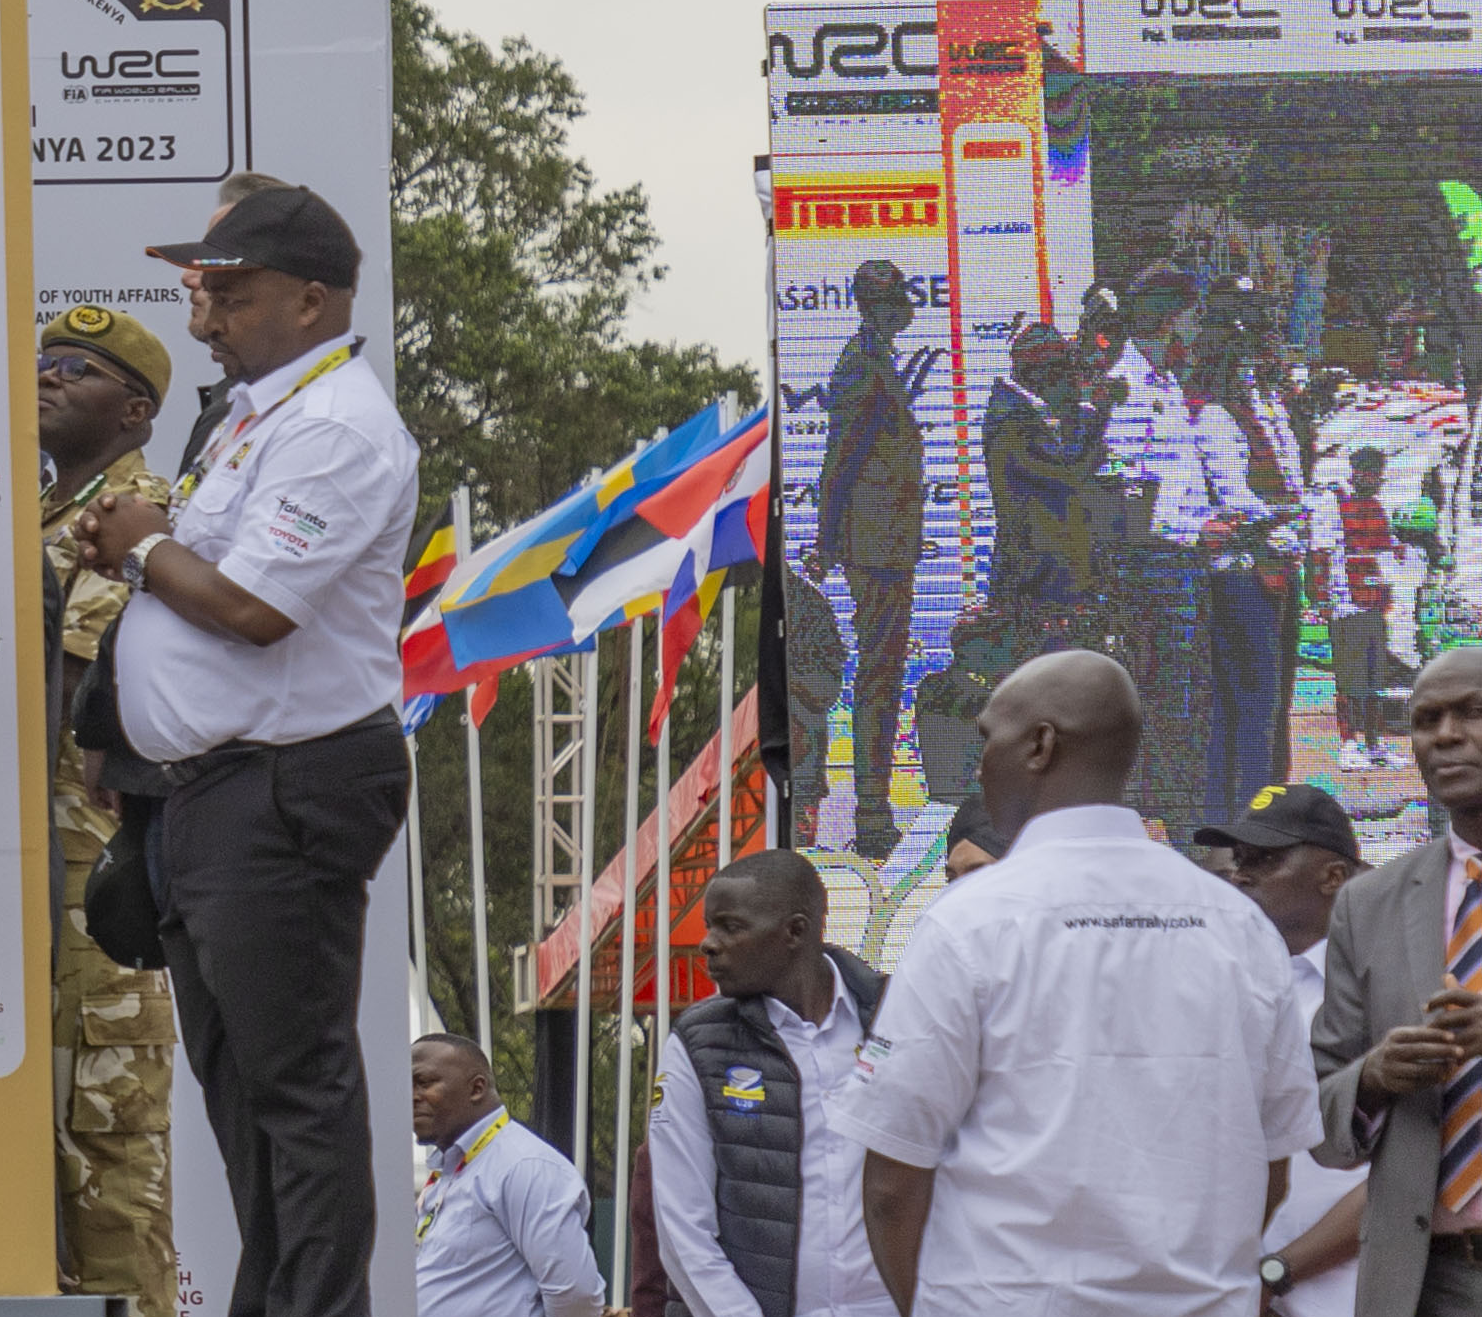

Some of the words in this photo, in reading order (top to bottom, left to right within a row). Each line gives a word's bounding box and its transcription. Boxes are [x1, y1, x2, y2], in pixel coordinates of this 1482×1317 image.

[61, 49, 200, 79] WRC
[32, 138, 86, 163] NYA
[96, 135, 177, 162] 2023
[39, 290, 59, 304] OF
[63, 289, 113, 303] YOUTH
[117, 288, 184, 305] AFFAIRS,
[269, 526, 310, 551] TOYOTA
[1063, 913, 1207, 933] www.safarirally.co.ke
